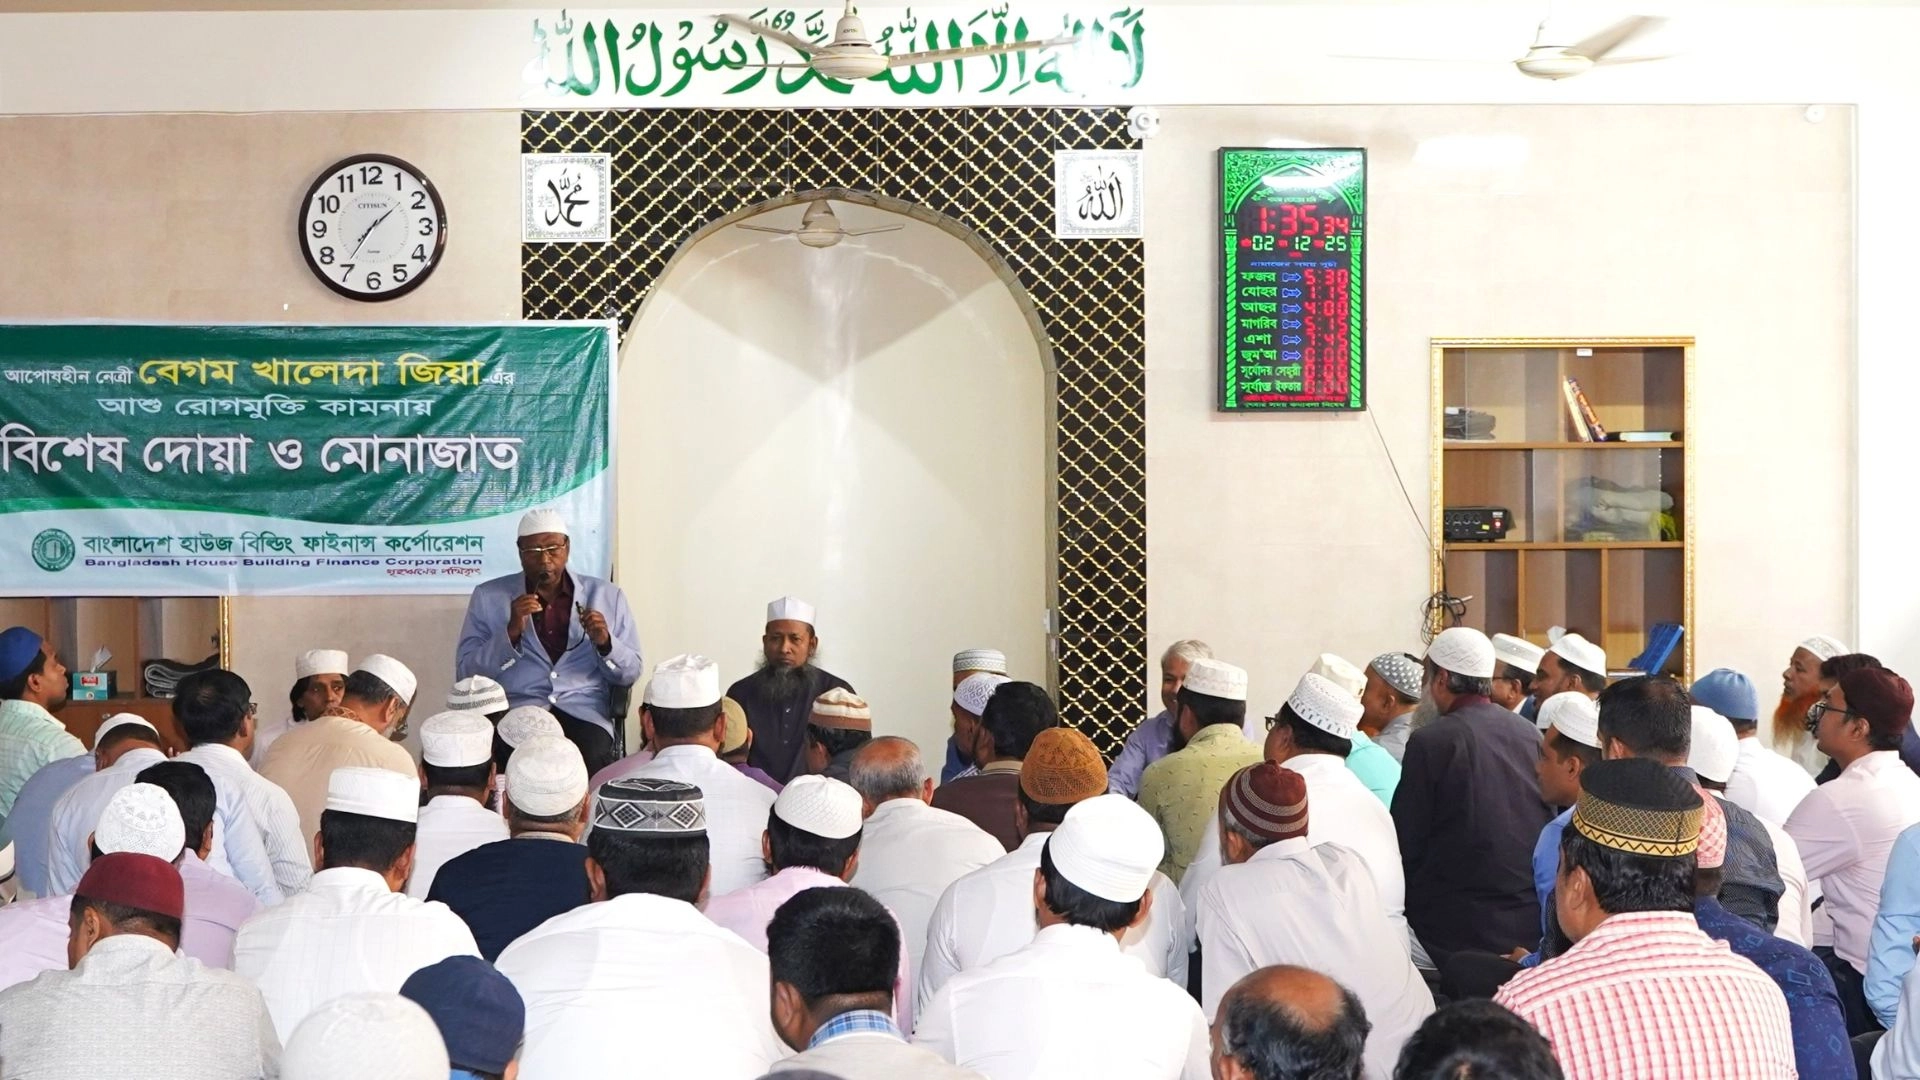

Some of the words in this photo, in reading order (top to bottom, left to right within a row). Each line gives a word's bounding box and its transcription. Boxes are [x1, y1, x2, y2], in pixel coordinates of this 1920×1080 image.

[337, 174, 354, 193] 11
[360, 166, 383, 185] 12
[394, 172, 402, 191] 1
[318, 195, 340, 214] 10
[411, 191, 426, 210] 2
[312, 220, 327, 238] 9
[418, 217, 433, 236] 3
[319, 246, 335, 265] 8
[411, 244, 427, 262] 4
[340, 264, 355, 282] 7
[366, 272, 381, 290] 6
[393, 264, 408, 282] 5
[4, 365, 91, 385] আপোষহীন
[95, 365, 134, 385] নেত্রী
[138, 358, 239, 386] বেগম
[251, 357, 385, 386] খালেদা
[96, 397, 163, 417] আশু
[175, 393, 309, 422] রোগমুক্তি
[316, 397, 436, 418] কামনায়
[0, 422, 129, 475] বিশেষ
[143, 433, 254, 475] দোয়া
[267, 438, 303, 471] ও
[320, 432, 524, 475] মোনাজাত
[82, 534, 173, 554] বাংলাদেশ
[178, 530, 235, 554] হাউজ
[239, 530, 296, 554] বিল্ডিং
[300, 530, 379, 553] ফাইনান্স
[382, 529, 485, 553] কর্পোরেশন
[84, 558, 181, 568] Bangladesh
[186, 558, 238, 567] House
[243, 558, 311, 567] Building
[316, 558, 380, 566] Finance
[385, 557, 483, 568] Corporation
